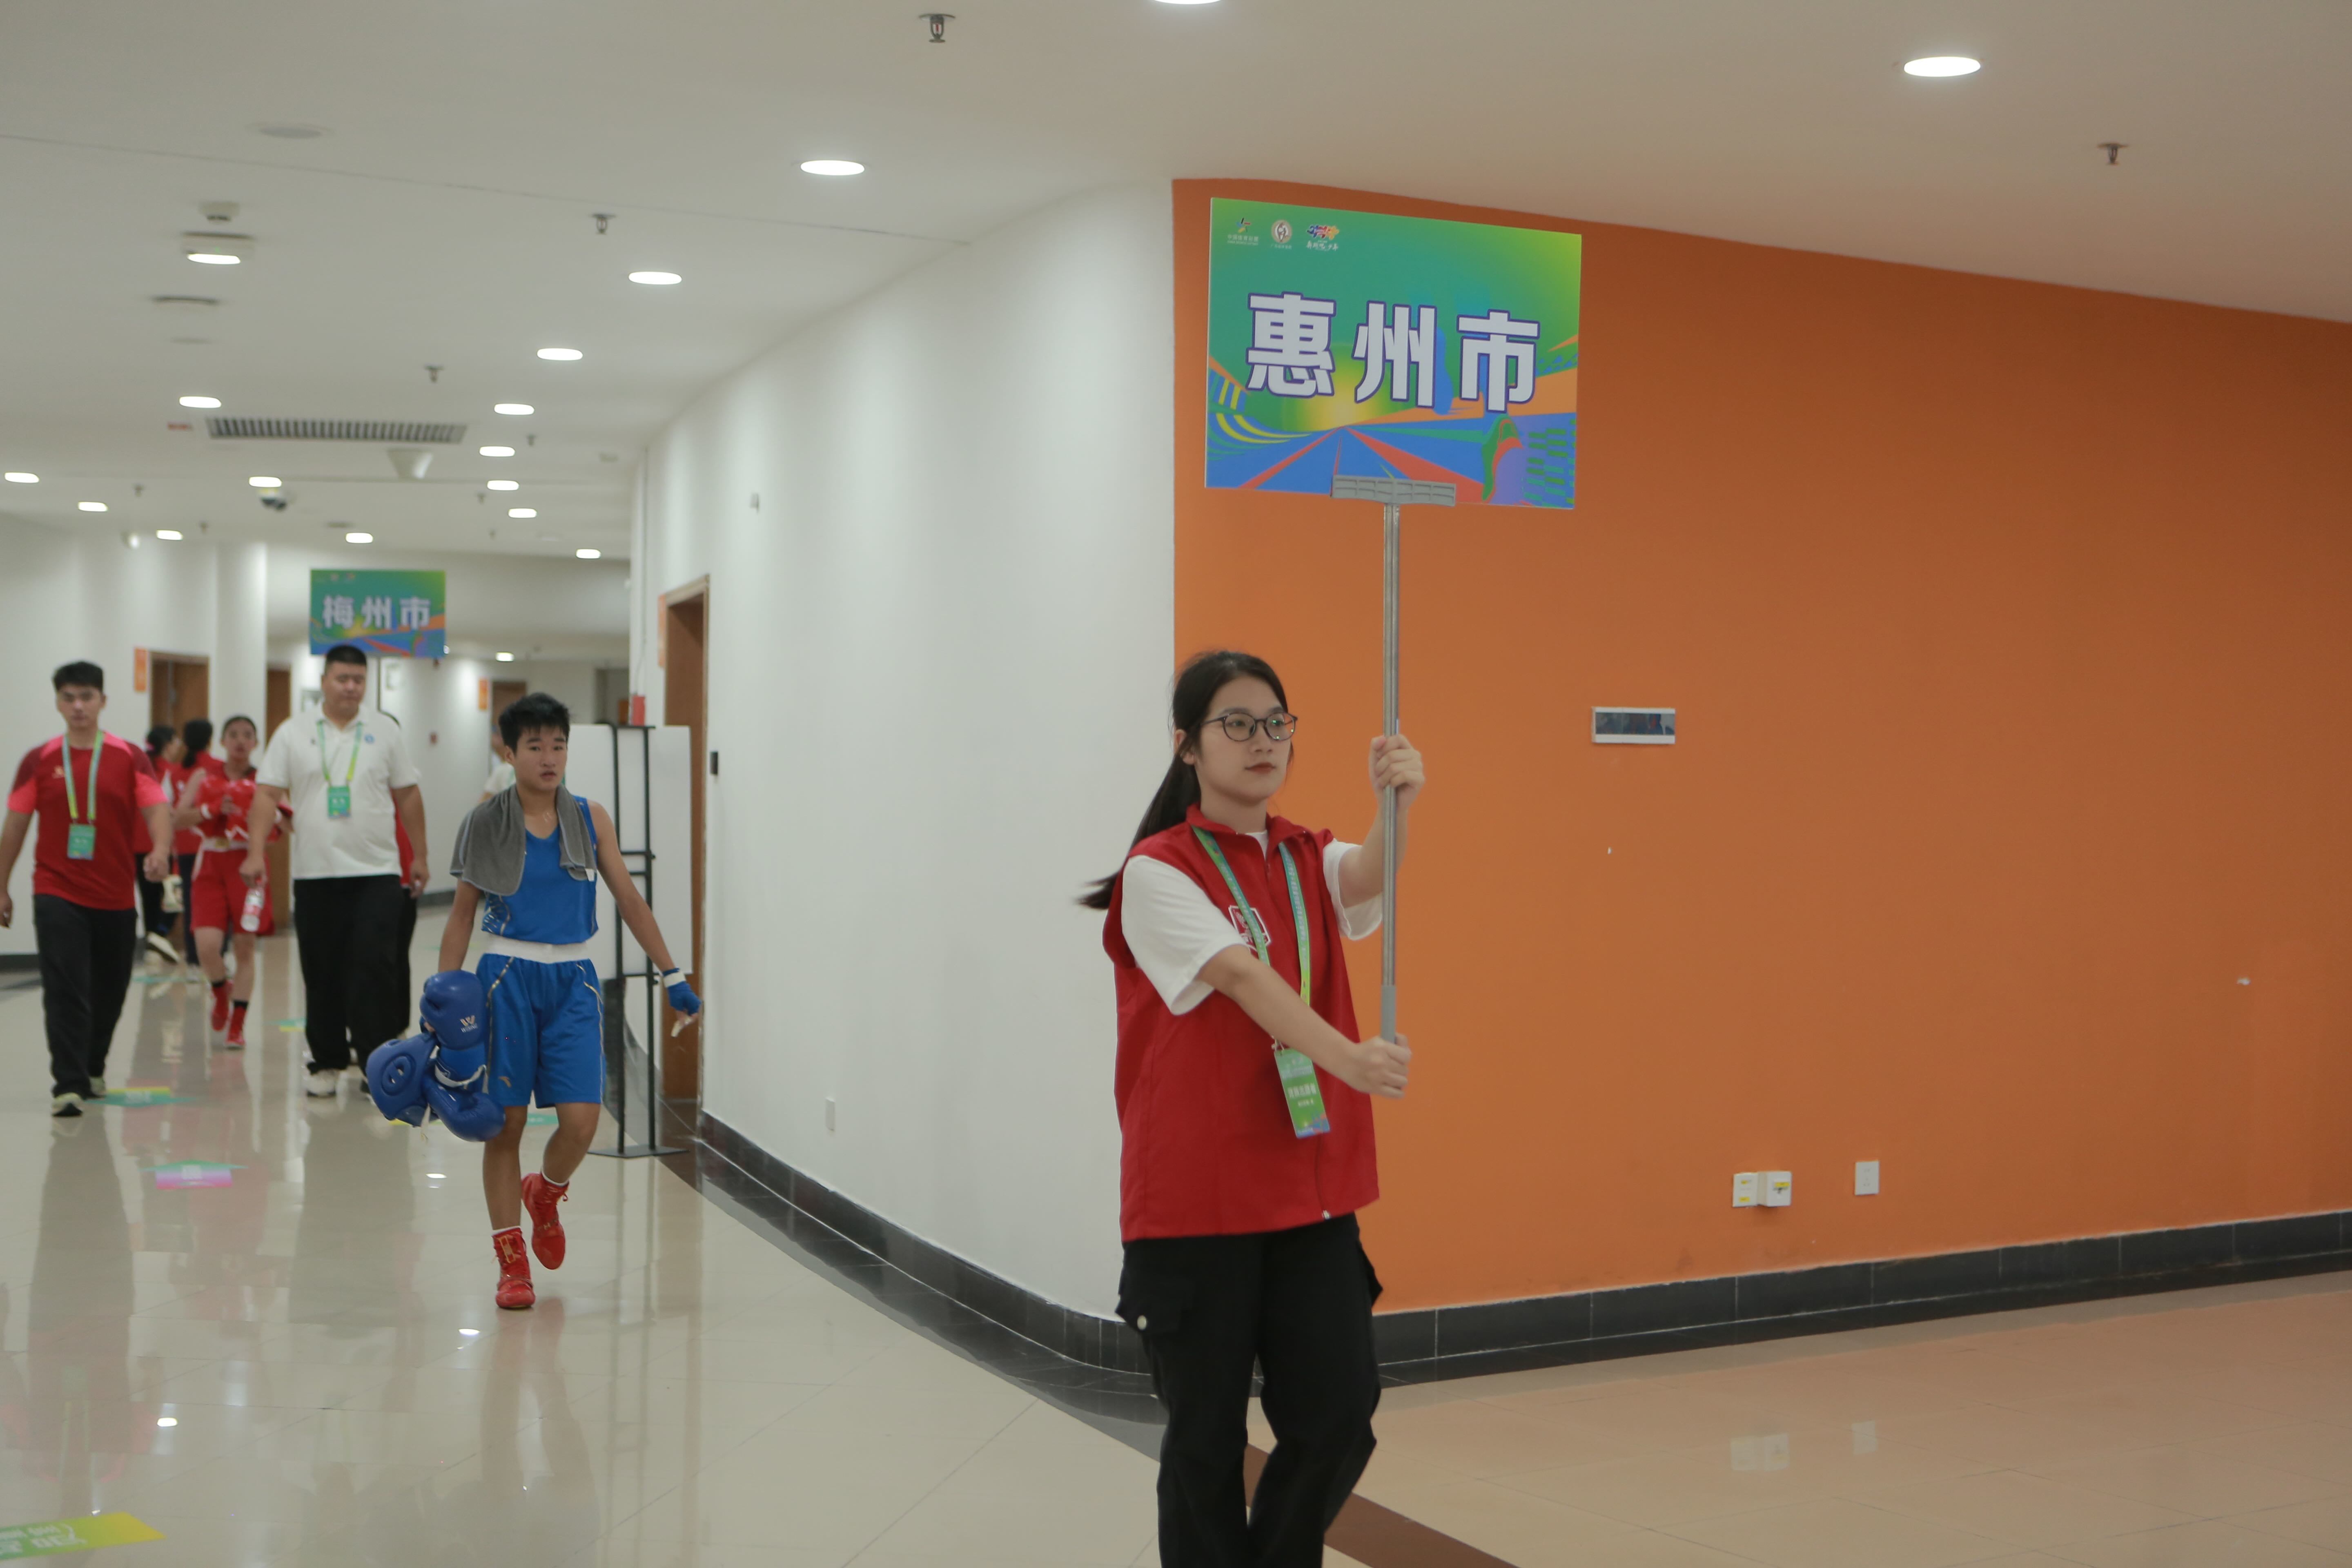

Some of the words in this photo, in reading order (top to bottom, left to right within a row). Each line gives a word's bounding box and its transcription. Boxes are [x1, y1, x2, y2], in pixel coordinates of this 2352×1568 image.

[1247, 292, 1540, 413] 惠州市
[323, 595, 431, 630] 梅州市
